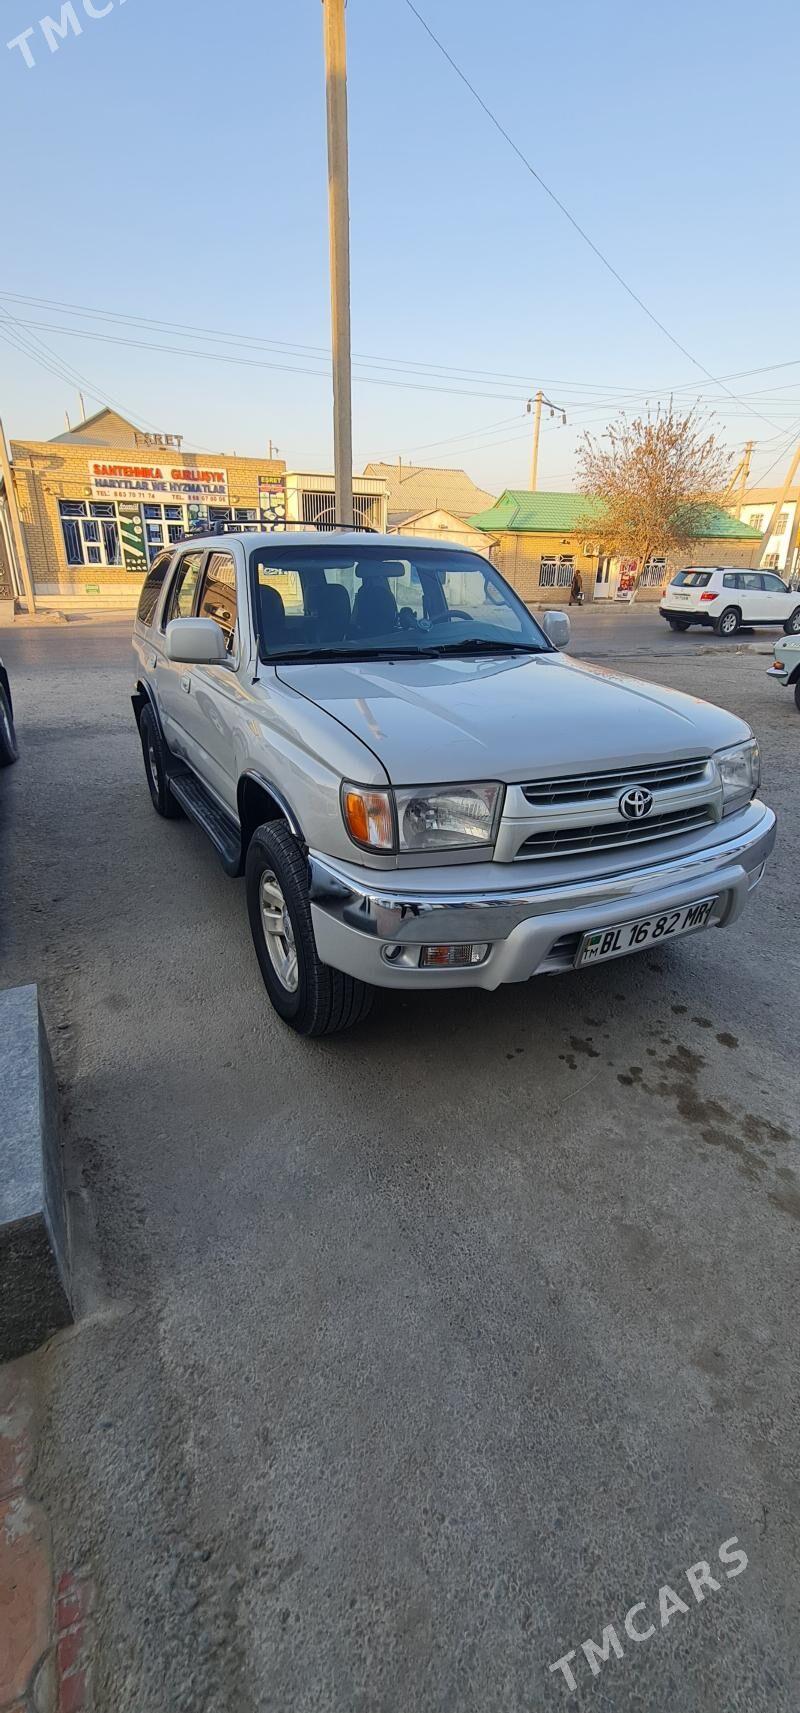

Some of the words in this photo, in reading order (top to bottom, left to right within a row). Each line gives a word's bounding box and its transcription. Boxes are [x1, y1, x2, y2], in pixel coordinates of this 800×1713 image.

[94, 478, 149, 490] HARYTLAR
[151, 481, 168, 491] WE
[169, 482, 226, 494] HYZMATLAR
[600, 931, 622, 954] BL
[628, 921, 651, 946] 16
[652, 913, 681, 938] 82
[681, 904, 707, 929] MR
[583, 947, 599, 960] TM
